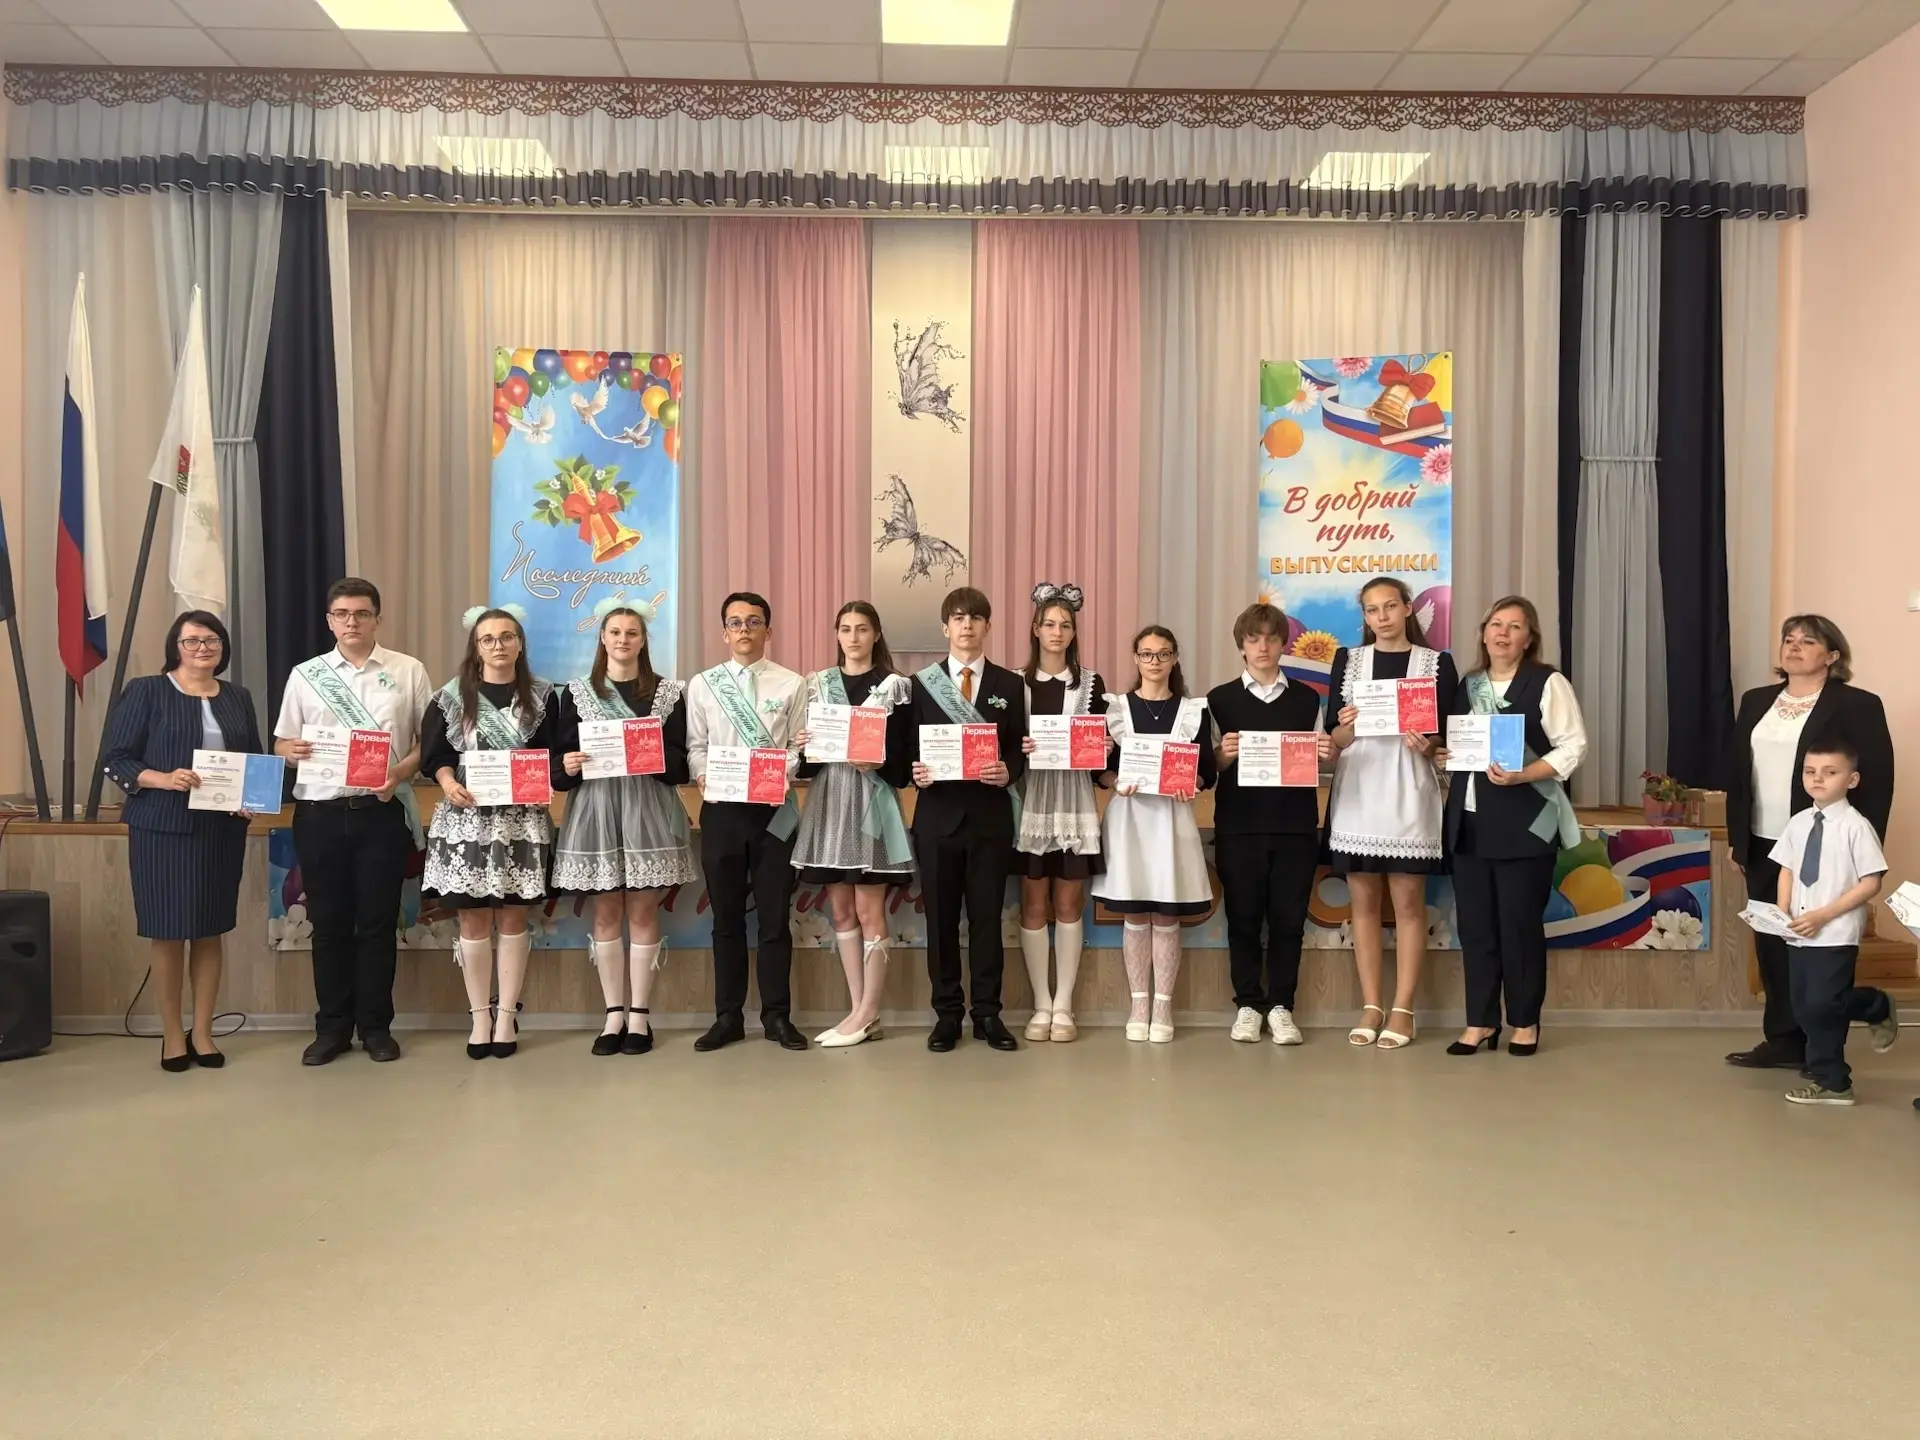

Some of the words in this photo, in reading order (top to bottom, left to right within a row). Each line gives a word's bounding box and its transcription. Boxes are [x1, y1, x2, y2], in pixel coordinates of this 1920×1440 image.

[1283, 486, 1309, 514] В
[1307, 481, 1419, 522] добрый
[1316, 522, 1395, 552] путь,
[502, 521, 651, 609] Последний
[1270, 553, 1438, 575] ВЫПУСКНИКИ
[1397, 681, 1434, 691] Первые
[851, 708, 886, 720] Первые
[623, 721, 660, 732] Первые
[1070, 718, 1105, 728] Первые
[351, 731, 390, 743] Первые
[962, 727, 997, 737] Первые
[1281, 734, 1316, 744] Первые
[1163, 744, 1198, 755] Первые
[511, 752, 549, 762] Первые
[750, 750, 786, 761] Первые
